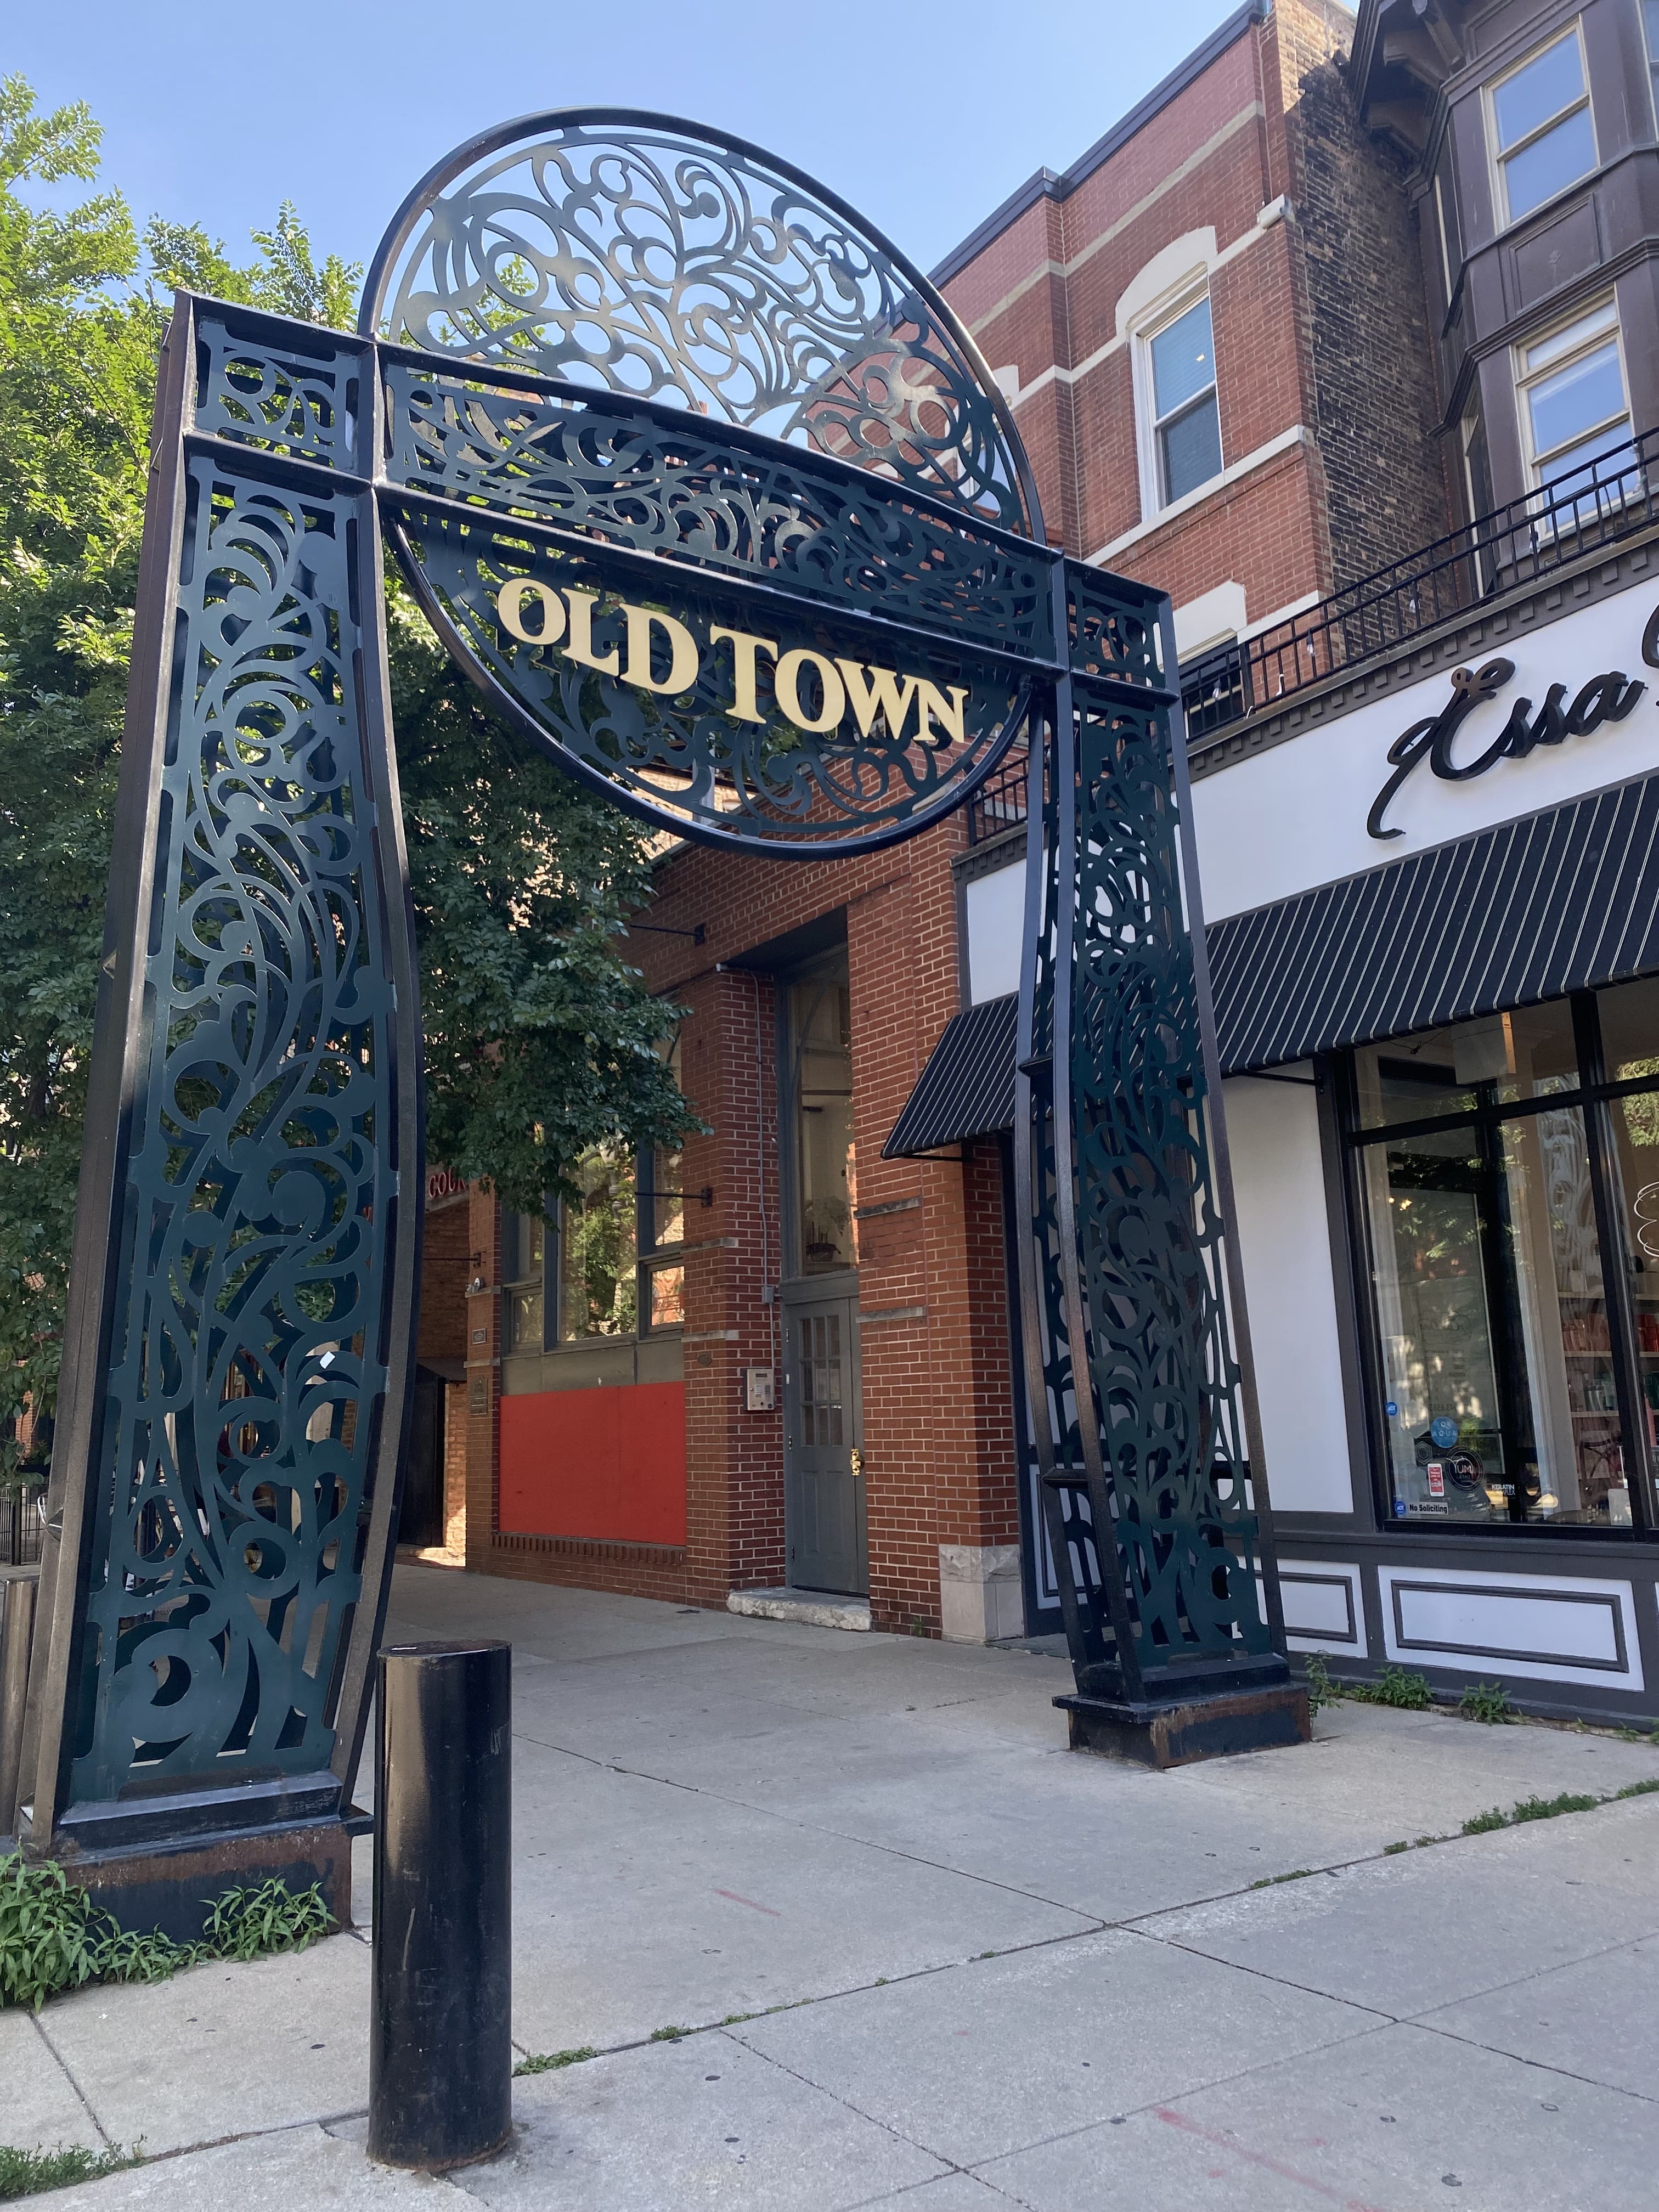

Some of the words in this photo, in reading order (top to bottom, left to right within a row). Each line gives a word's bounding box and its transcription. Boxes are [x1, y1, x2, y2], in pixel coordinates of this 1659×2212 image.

[496, 578, 699, 695] OLD
[709, 623, 969, 743] TOWN
[1419, 1504, 1448, 1514] Soliciting
